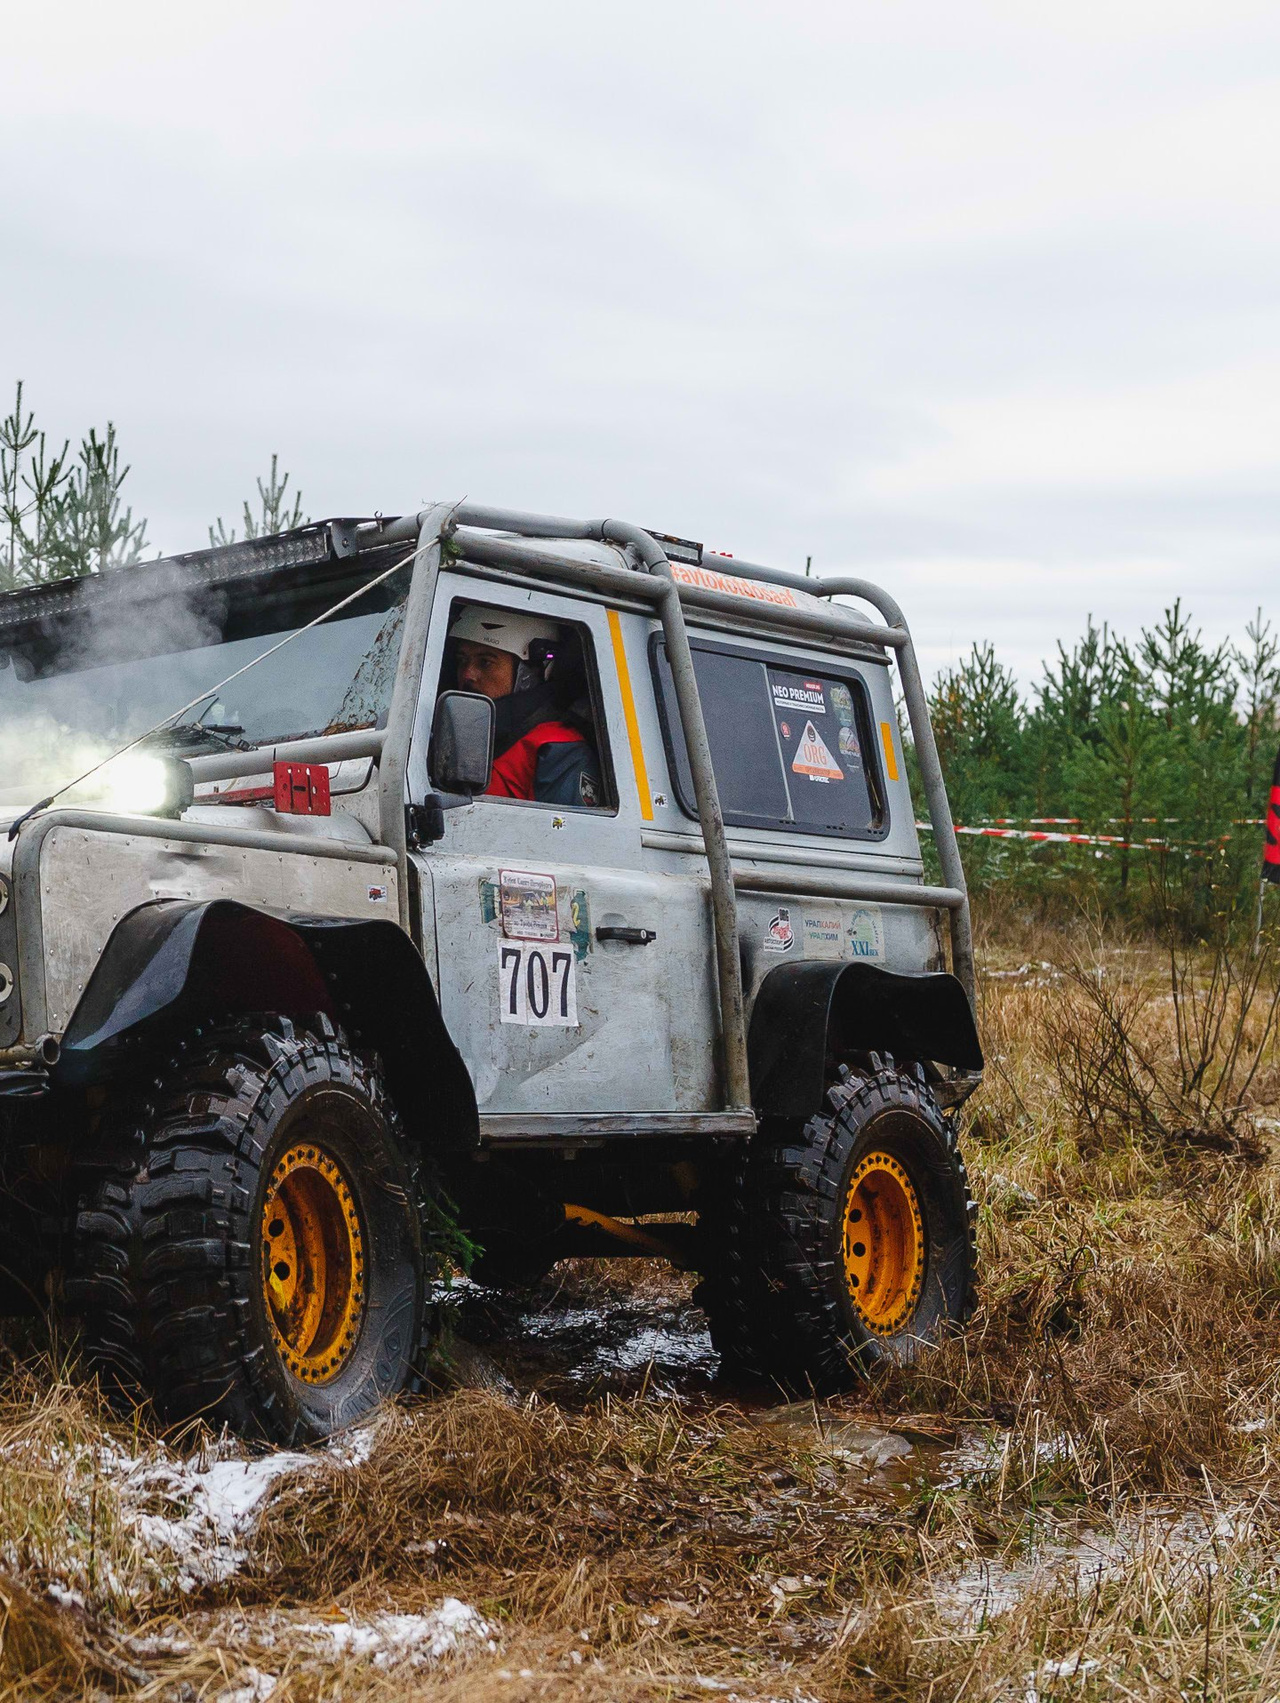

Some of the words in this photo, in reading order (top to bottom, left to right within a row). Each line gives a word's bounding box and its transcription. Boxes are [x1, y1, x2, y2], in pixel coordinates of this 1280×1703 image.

[772, 684, 789, 699] NEO
[789, 687, 825, 705] PREMIUM
[803, 743, 828, 766] ORG
[809, 931, 839, 941] УРАЛХИМ
[850, 940, 869, 956] XXI
[501, 947, 572, 1019] 707
